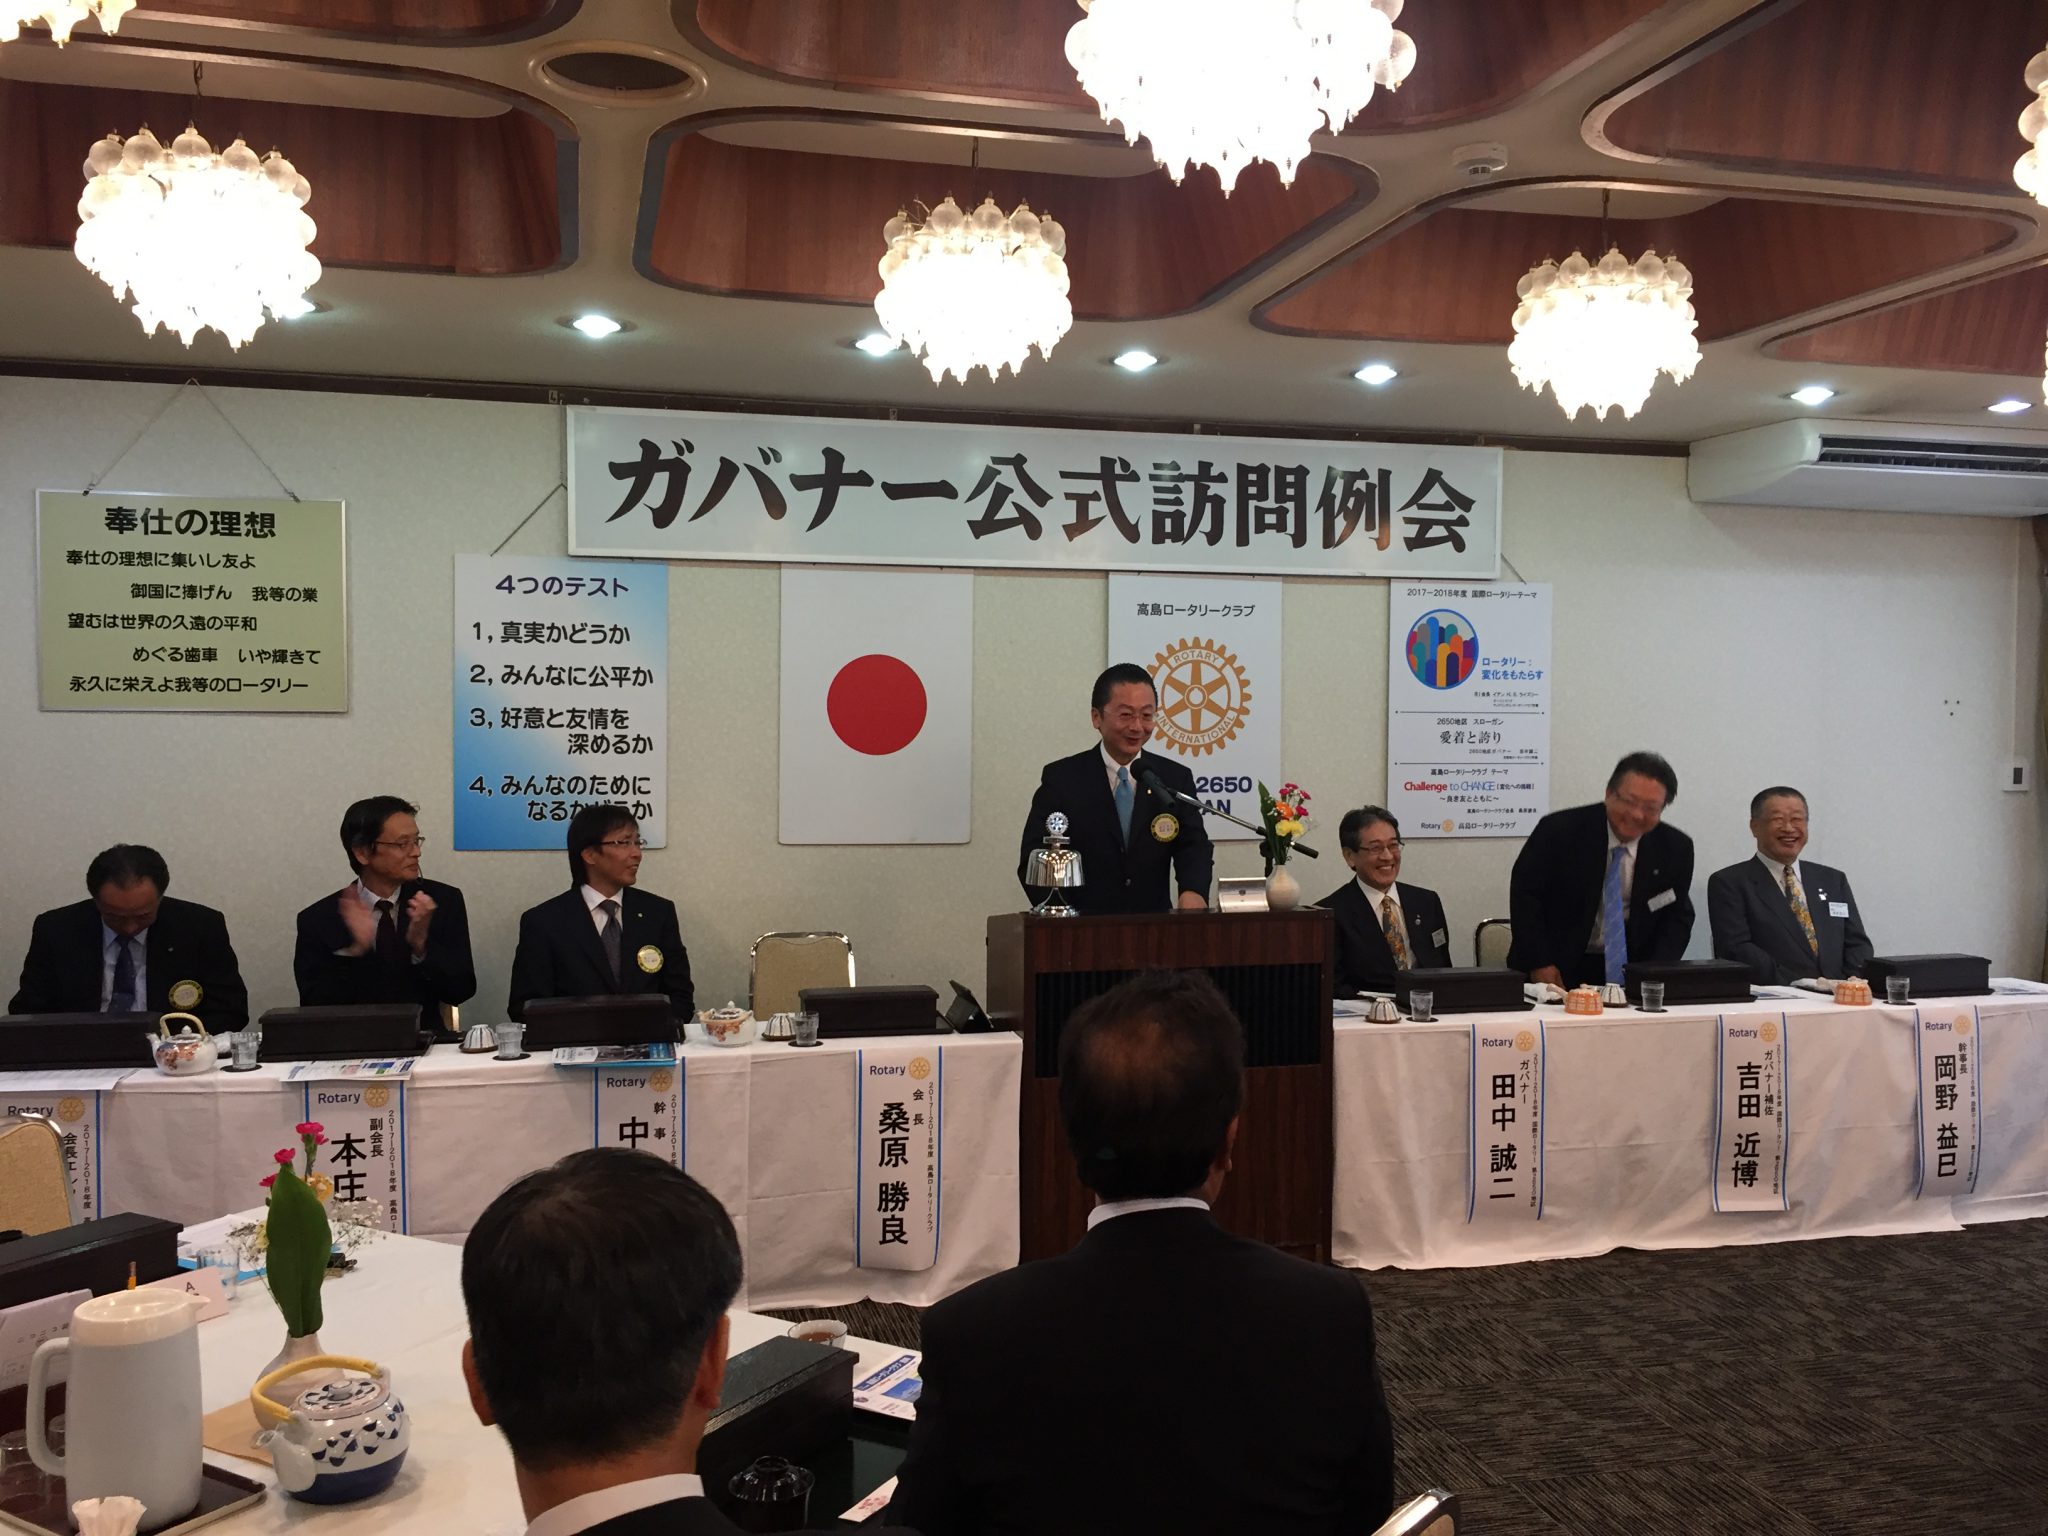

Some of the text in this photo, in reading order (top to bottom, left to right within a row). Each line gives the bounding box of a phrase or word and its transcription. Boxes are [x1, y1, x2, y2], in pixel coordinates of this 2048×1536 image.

[605, 438, 1476, 553] ガバナー公式訪問例会
[105, 506, 277, 538] 奉仕の理想
[66, 550, 256, 569] 奉仕の理想に集いし友よ
[131, 583, 318, 603] 御国に捧げん 我等の業
[495, 575, 629, 597] 4つのテスト
[1472, 590, 1537, 598] 国際ロータリーテーマ
[1137, 603, 1255, 617] 高島ロータリークラブ
[68, 613, 257, 631] 望むは世界の久遠の平和
[133, 647, 321, 665] めぐる歯車 いや輝きて
[1173, 650, 1219, 664] ROTARY
[1481, 669, 1543, 680] 変化をもたらす
[70, 676, 308, 693] 永久に栄えよ我等のロータリー
[1159, 715, 1235, 743] INTERNATIONAL
[1440, 731, 1501, 744] 愛着と誇り
[567, 734, 653, 755] 深めるか
[1431, 768, 1487, 776] 高島ロータリークラブ
[1196, 776, 1252, 793] 2650
[1404, 781, 1448, 793] Challenge
[1450, 783, 1460, 791] to
[1460, 781, 1495, 791] CHANGE
[1421, 822, 1441, 831] Rotary
[1729, 1028, 1758, 1038] Rotary
[1925, 1022, 1952, 1032] Rotary
[1482, 1038, 1514, 1048] Rotary
[1958, 1042, 1968, 1075] 幹事長
[869, 1065, 906, 1076] Rotary
[606, 1077, 646, 1088] Rotary
[1519, 1059, 1531, 1104] ガバナー
[1764, 1050, 1774, 1116] ガバナー補佐
[1935, 1054, 1959, 1111] 岡野
[318, 1092, 361, 1105] Rotary
[912, 1088, 924, 1126] 会長
[653, 1101, 667, 1140] 幹事
[1732, 1061, 1762, 1188] 吉田 近博
[369, 1117, 384, 1158] 副会長
[619, 1116, 649, 1149] 中
[1489, 1074, 1517, 1200] 田中 誠二
[330, 1133, 368, 1203] 本庄
[877, 1102, 910, 1246] 桑原 勝良
[389, 1199, 398, 1233] 高島ロー
